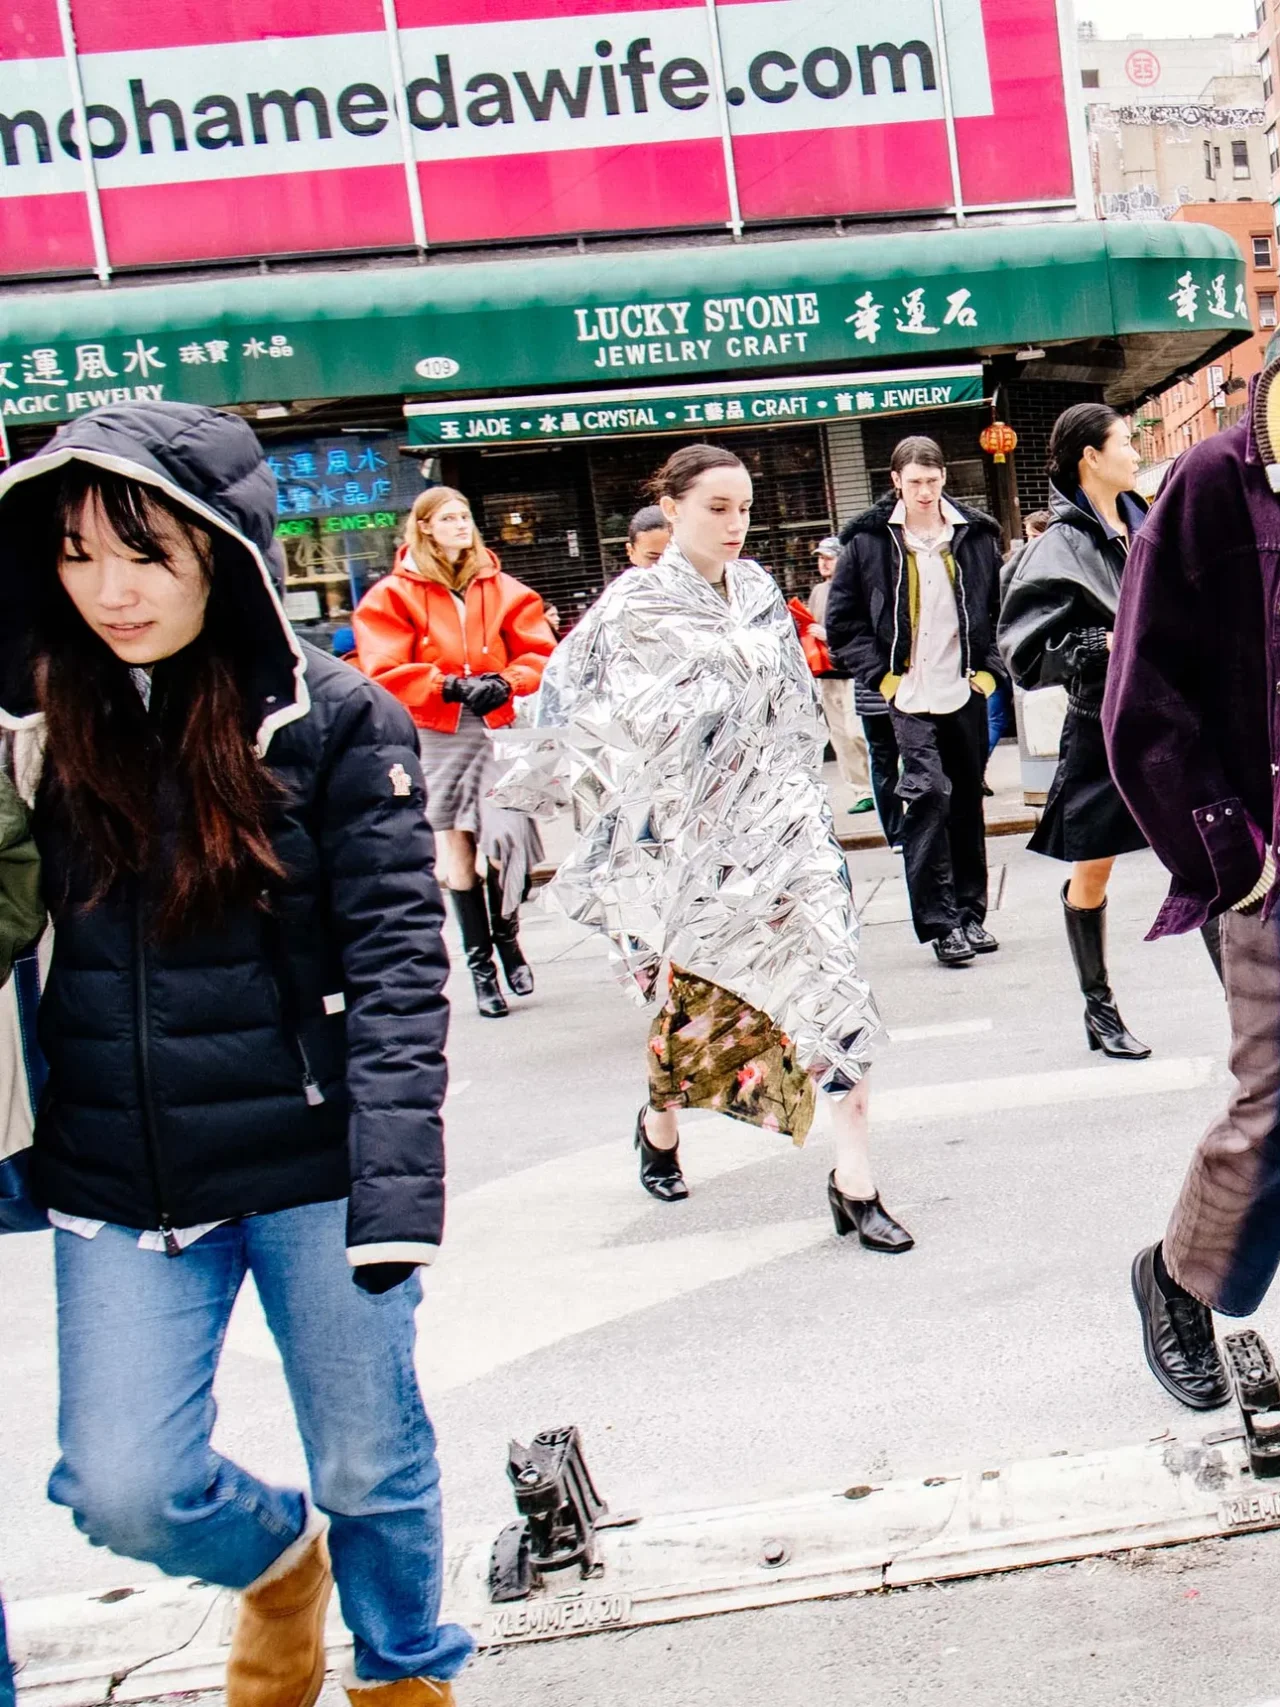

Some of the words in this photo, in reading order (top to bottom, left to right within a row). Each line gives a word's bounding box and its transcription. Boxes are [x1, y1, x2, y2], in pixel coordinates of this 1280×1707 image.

[574, 302, 691, 341] LUCKY
[704, 293, 820, 332] STONE
[243, 335, 293, 359] 水晶
[594, 339, 712, 368] JEWELRY
[726, 332, 808, 358] CRAFT
[424, 360, 451, 376] 109
[66, 384, 164, 413] JEWELRY
[440, 421, 462, 440] 玉
[465, 417, 511, 438] JADE
[539, 412, 580, 433] 水晶
[583, 408, 658, 430] CRYSTAL
[684, 401, 744, 422] 工藝品
[751, 397, 808, 418] CRAFT
[880, 386, 952, 408] JEWELRY
[600, 1596, 622, 1623] 20
